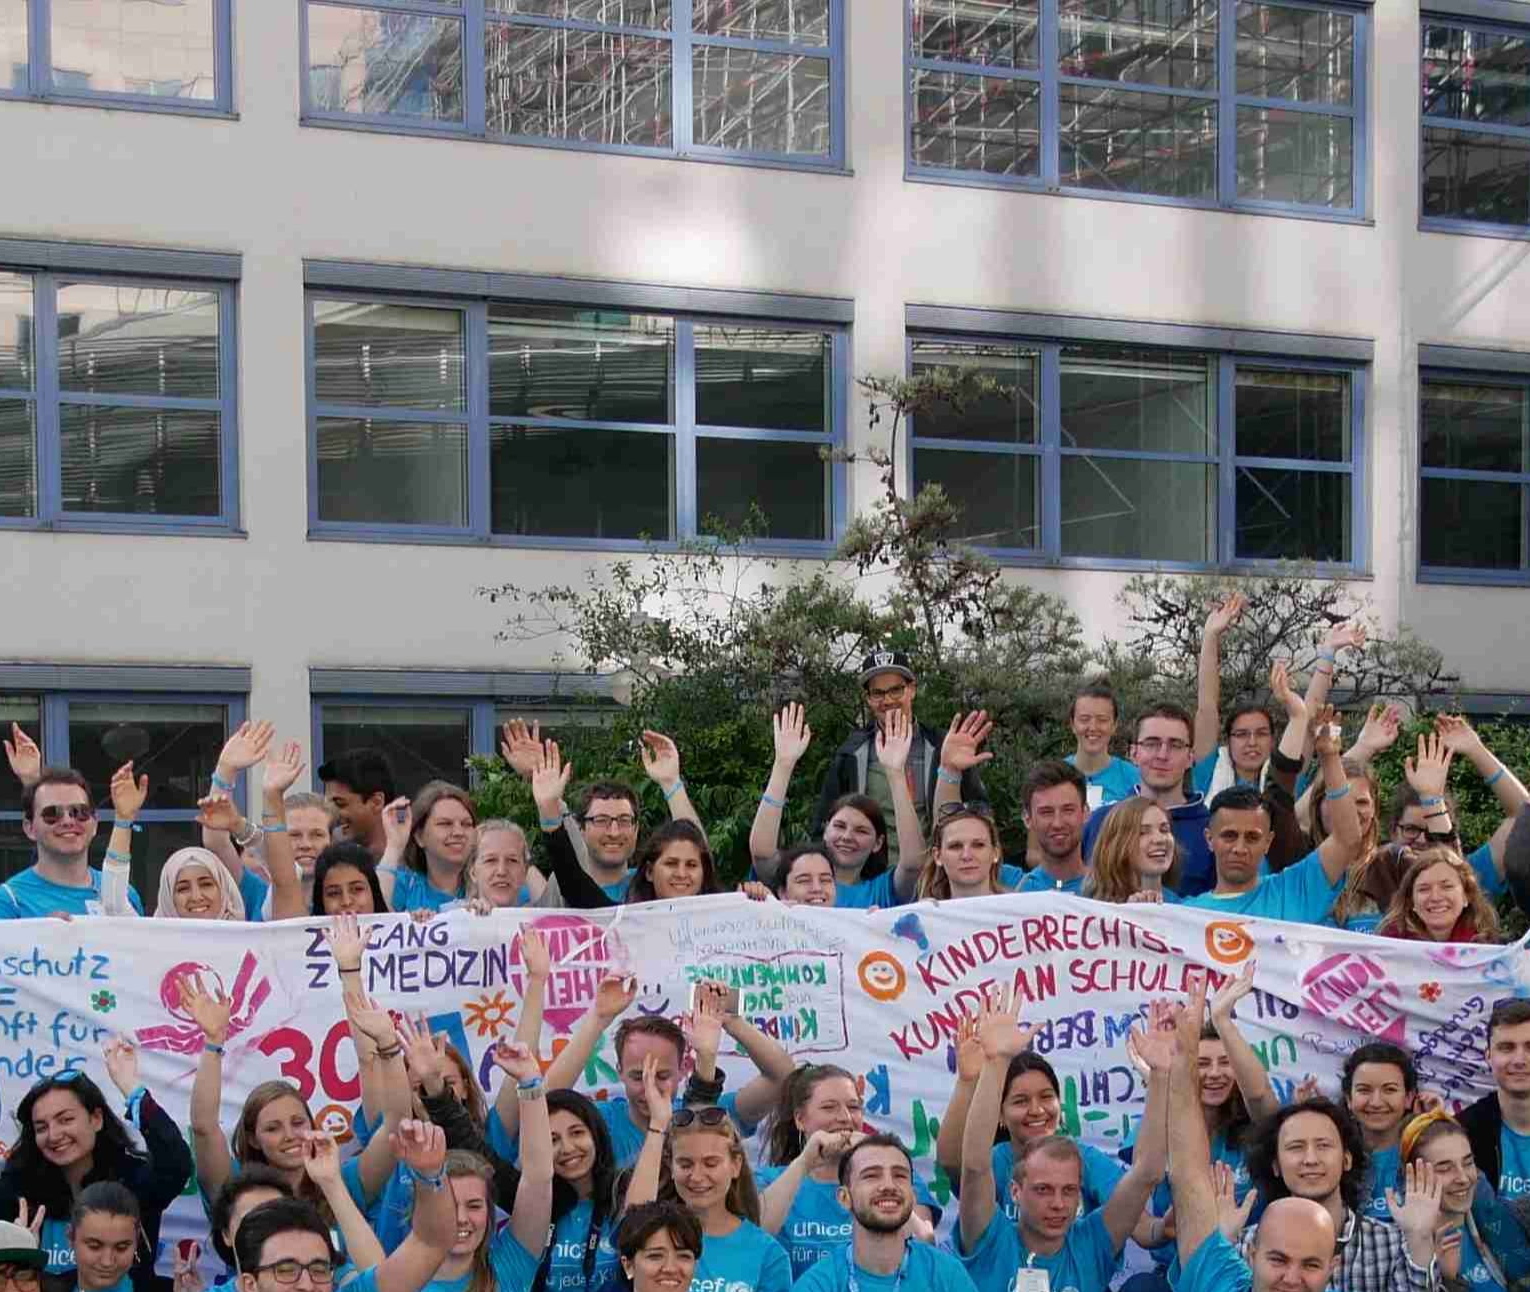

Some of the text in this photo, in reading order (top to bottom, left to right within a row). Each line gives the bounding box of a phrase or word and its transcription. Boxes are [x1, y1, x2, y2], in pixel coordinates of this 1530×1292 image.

[305, 921, 448, 958] ZGANG
[915, 914, 1185, 996] KINDERRECHTS-
[369, 943, 509, 993] MEDIZIN
[1013, 966, 1058, 1002] AN
[53, 1008, 112, 1046] für
[793, 1220, 853, 1238] unice
[46, 1242, 77, 1266] nice
